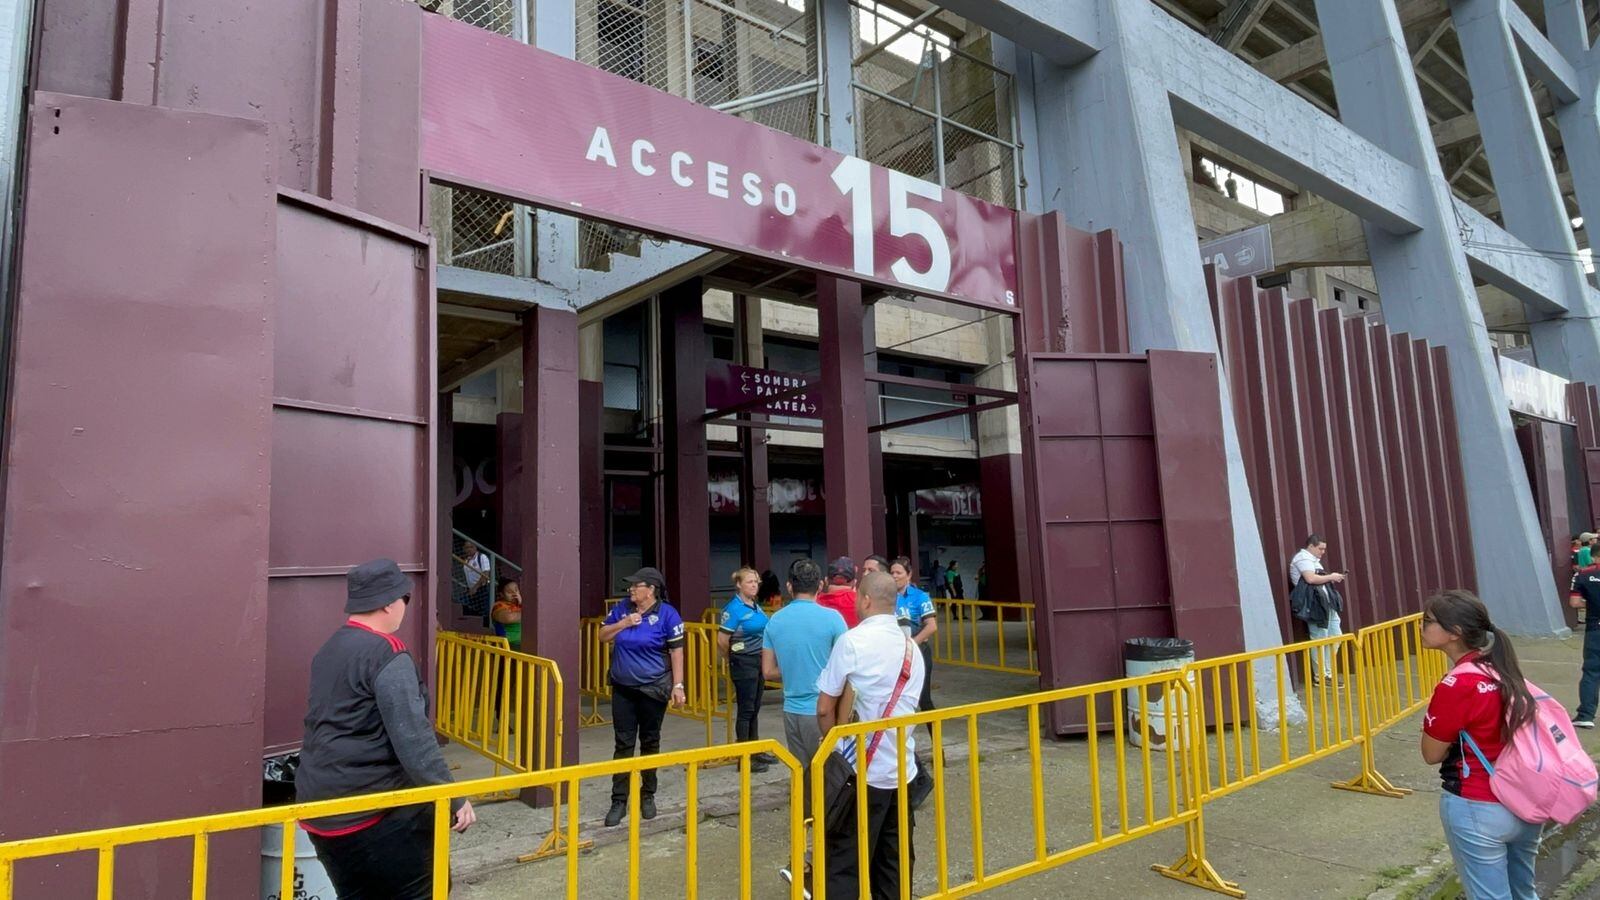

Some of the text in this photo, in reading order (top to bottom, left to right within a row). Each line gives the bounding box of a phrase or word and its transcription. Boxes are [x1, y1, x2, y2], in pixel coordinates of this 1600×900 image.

[585, 126, 953, 293] ACCESO 15
[755, 374, 806, 388] SOMBRA
